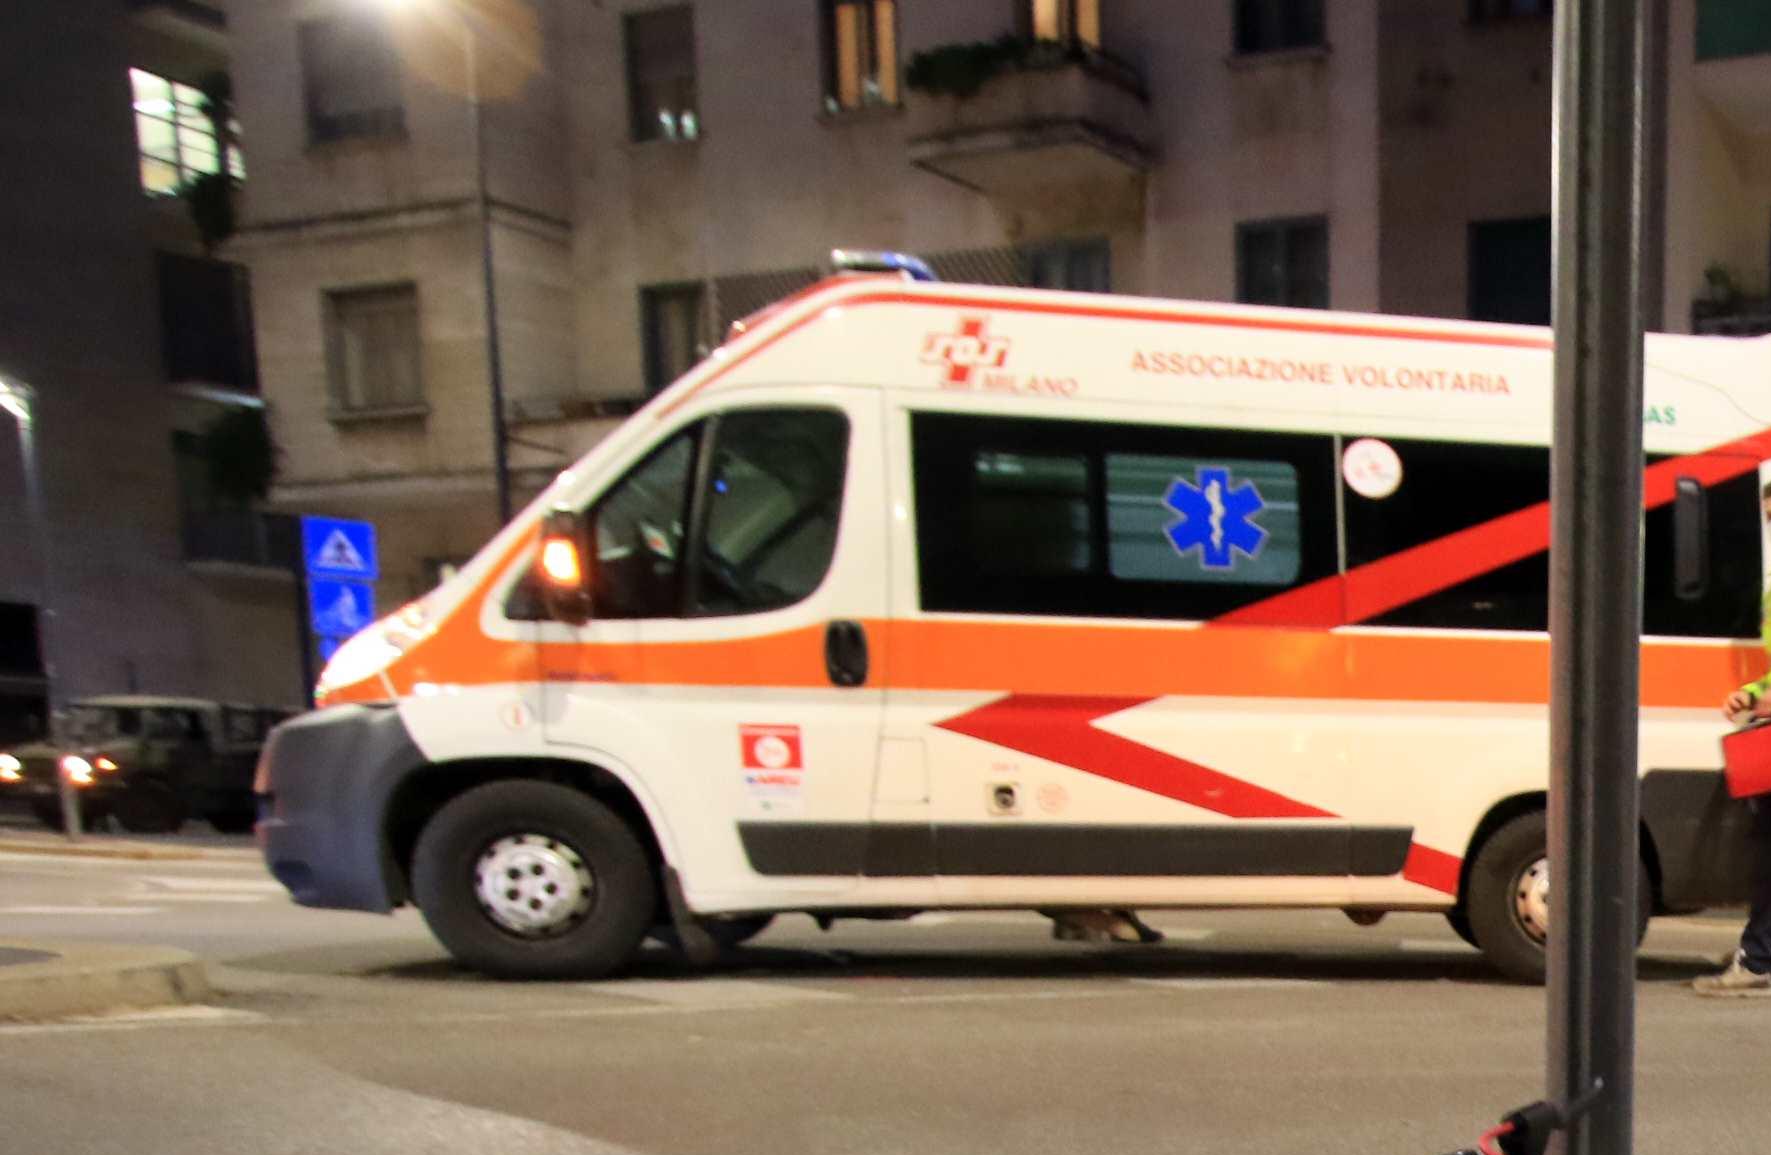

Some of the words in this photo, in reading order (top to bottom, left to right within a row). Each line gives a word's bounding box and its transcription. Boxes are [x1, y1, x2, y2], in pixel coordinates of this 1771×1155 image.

[982, 373, 1079, 398] MILANO
[1131, 350, 1335, 385] ASSOCIAZIONE
[1342, 364, 1511, 396] VOLONTARIA
